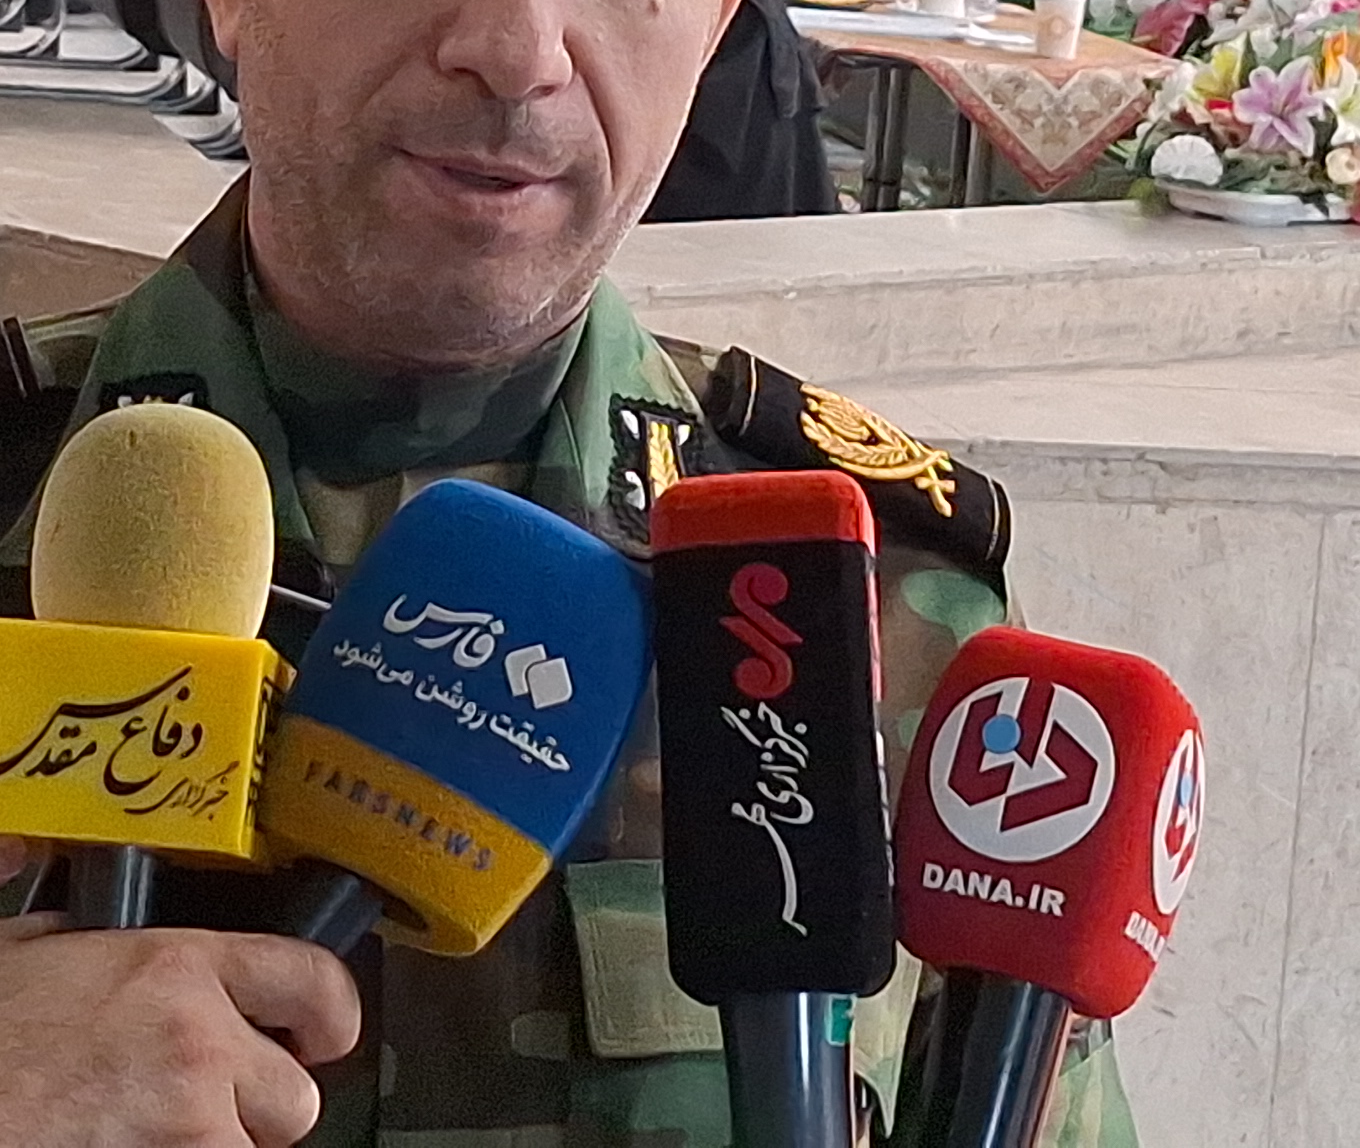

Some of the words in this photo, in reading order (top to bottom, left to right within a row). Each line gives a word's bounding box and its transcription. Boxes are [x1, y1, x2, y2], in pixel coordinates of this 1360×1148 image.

[382, 593, 504, 669] فارس
[415, 674, 488, 730] روشن
[103, 685, 202, 796] دفاع
[489, 712, 570, 772] حقیقت
[720, 701, 814, 825] خبرگزاری
[124, 760, 240, 822] خبرگزاری
[731, 802, 808, 937] مهر
[922, 862, 1066, 917] DANA.IR
